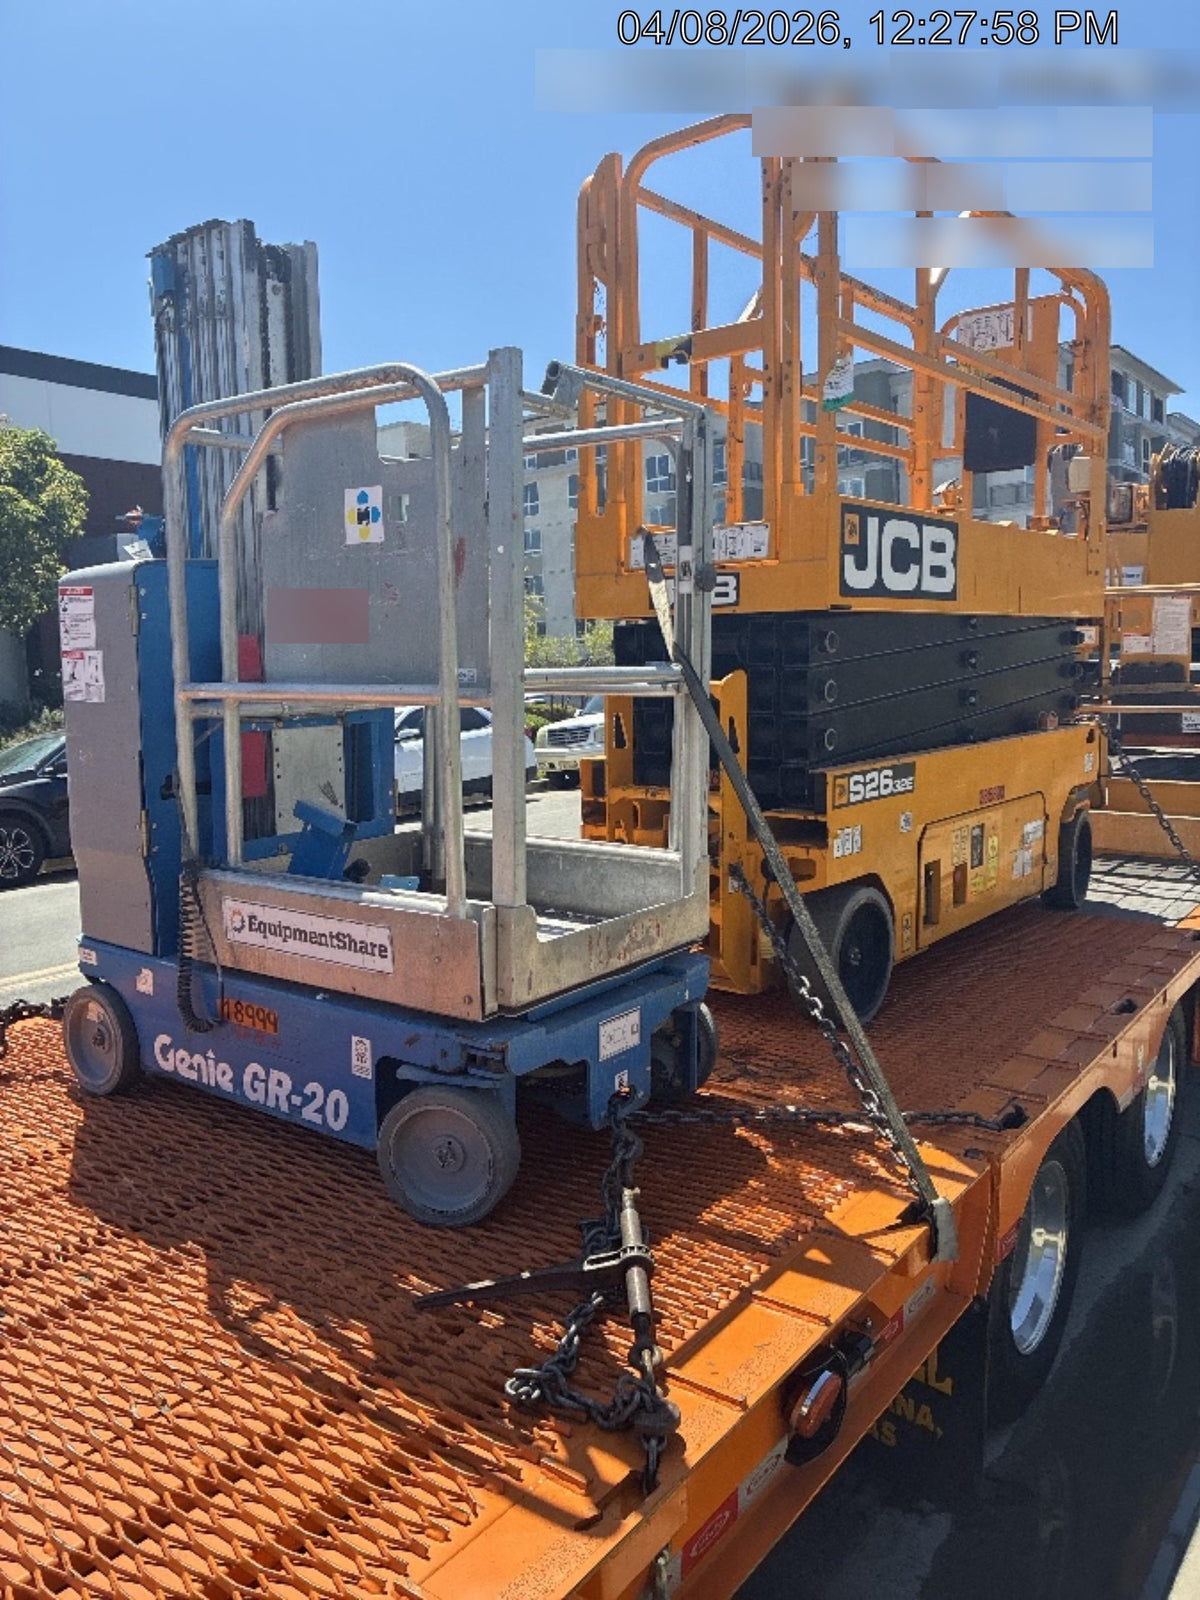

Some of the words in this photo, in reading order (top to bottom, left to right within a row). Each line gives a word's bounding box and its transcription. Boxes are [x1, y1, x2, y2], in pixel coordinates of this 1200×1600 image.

[844, 516, 956, 593] JCB
[247, 914, 389, 959] EquipmentShare
[153, 1033, 234, 1093] Genie
[242, 1062, 350, 1131] GR-20
